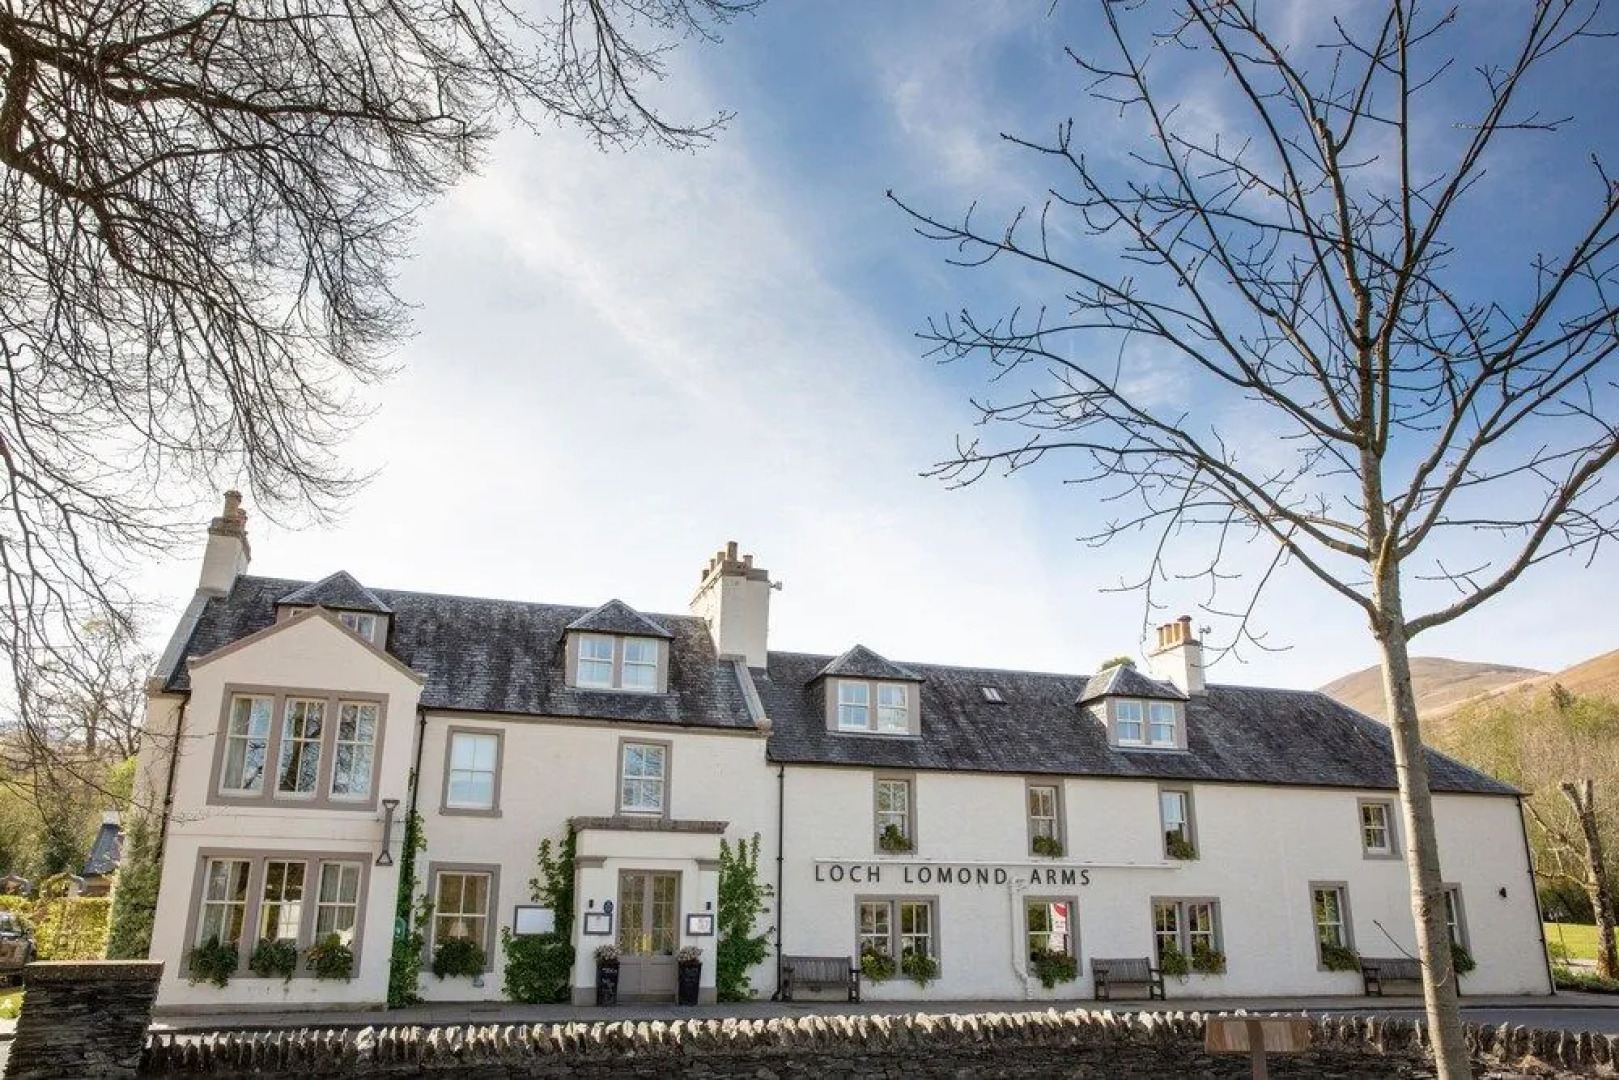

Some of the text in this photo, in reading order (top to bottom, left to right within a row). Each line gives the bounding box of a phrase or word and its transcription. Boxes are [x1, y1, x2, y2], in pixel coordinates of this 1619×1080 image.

[815, 865, 1090, 885] LOCH LOMOND ARMS
